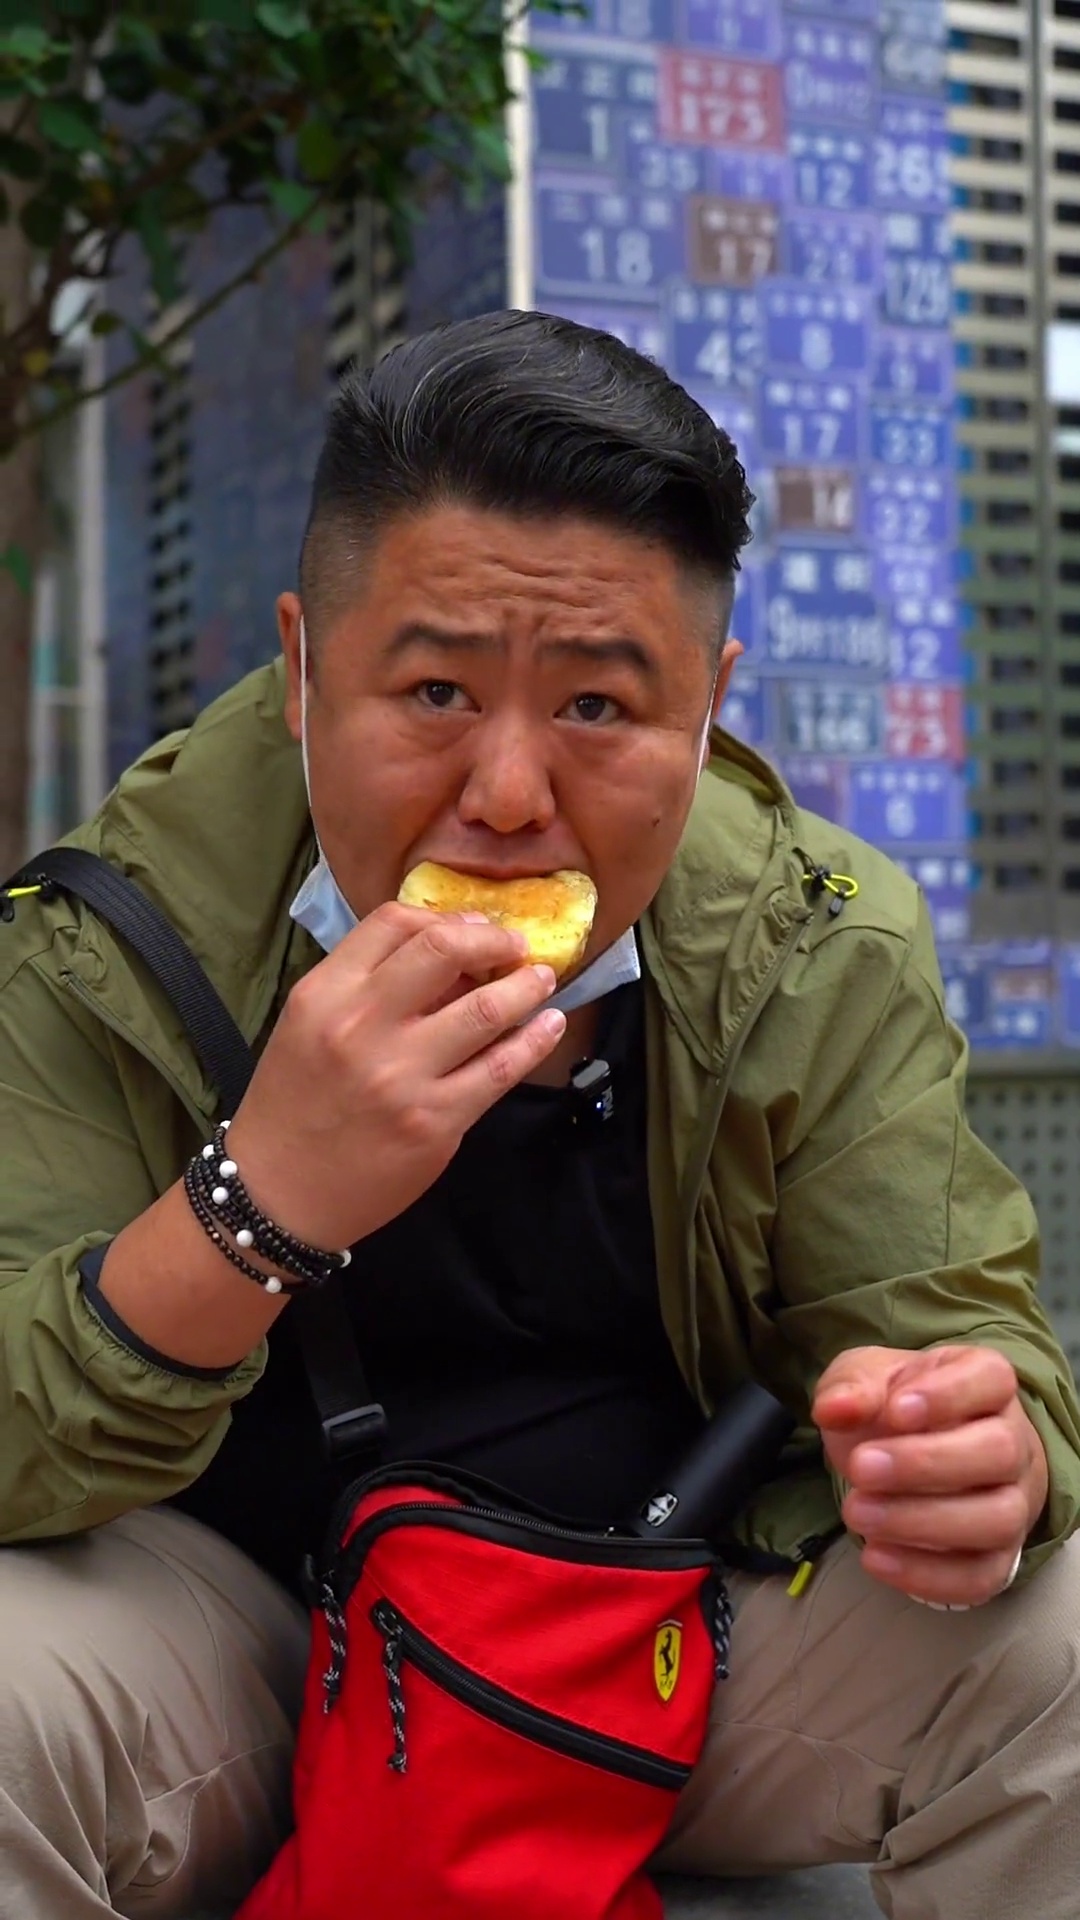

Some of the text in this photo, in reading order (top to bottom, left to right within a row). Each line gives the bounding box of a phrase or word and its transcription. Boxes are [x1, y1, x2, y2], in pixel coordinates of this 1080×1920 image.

[800, 161, 853, 208] 12
[580, 227, 652, 286] 18
[784, 412, 839, 458] 17
